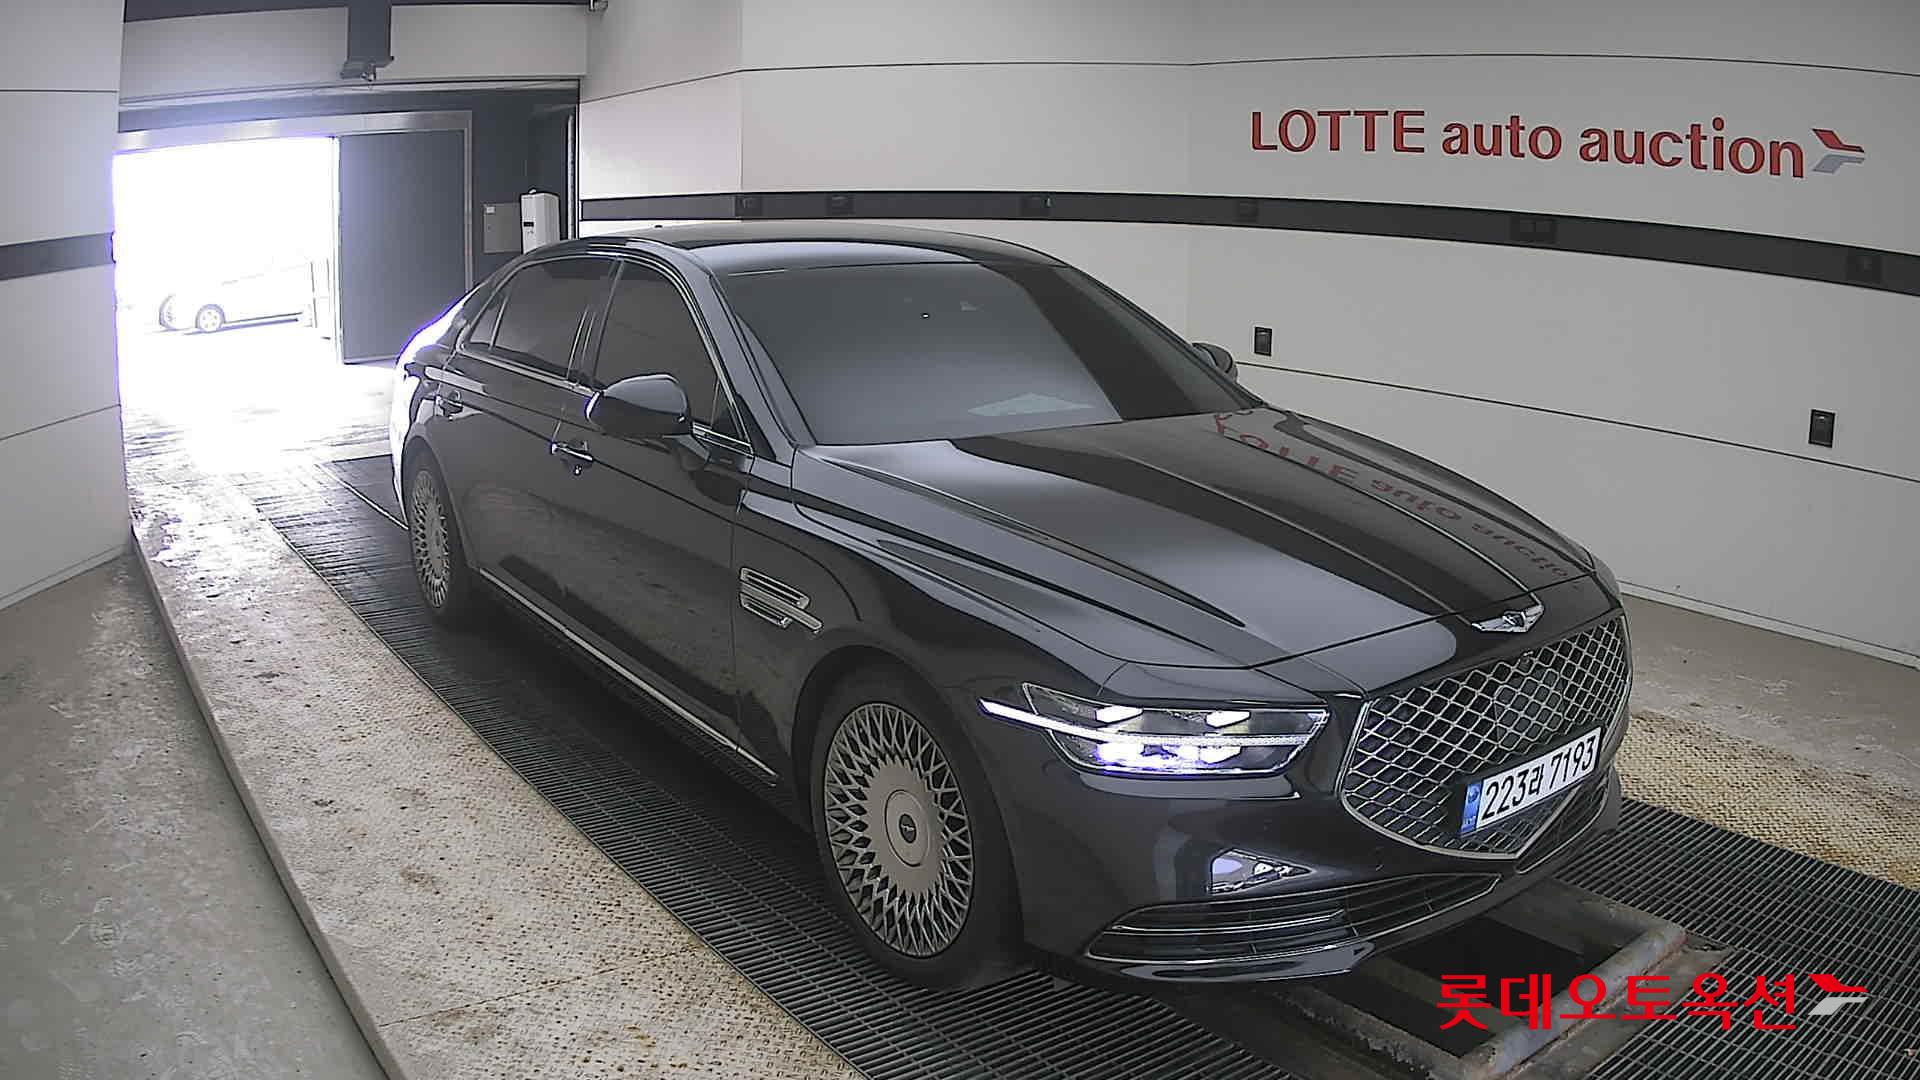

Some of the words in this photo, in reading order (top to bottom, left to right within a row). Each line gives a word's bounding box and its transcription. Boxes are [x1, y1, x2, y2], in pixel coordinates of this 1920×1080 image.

[1251, 109, 1425, 153] LOTTE
[1442, 115, 1562, 160] auto
[1579, 117, 1804, 178] auction
[1481, 763, 1545, 821] 223라
[1548, 735, 1597, 790] 7193
